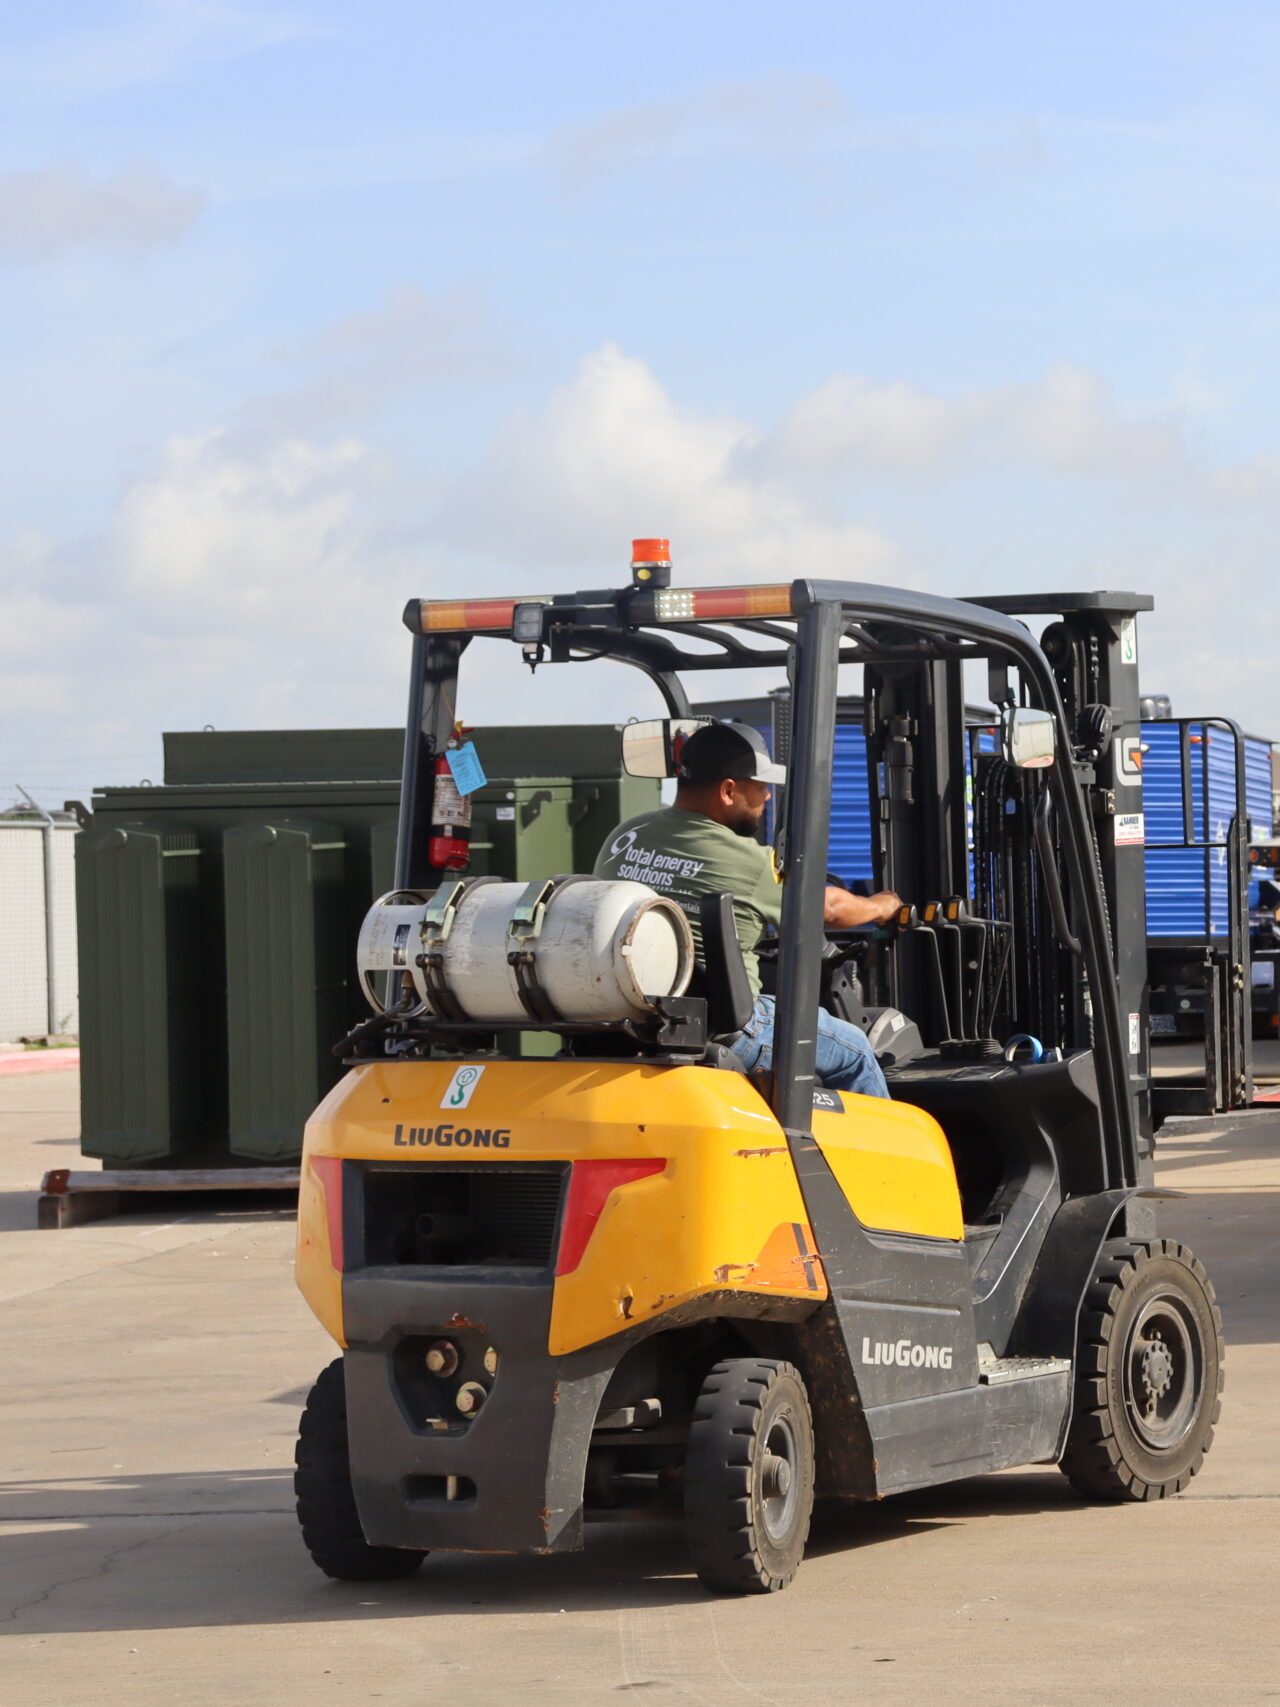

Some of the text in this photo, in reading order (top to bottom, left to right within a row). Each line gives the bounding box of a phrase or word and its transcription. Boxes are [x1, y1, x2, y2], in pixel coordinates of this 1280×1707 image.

[625, 845, 705, 877] total energy
[617, 863, 675, 886] solutions
[813, 1092, 835, 1107] 25
